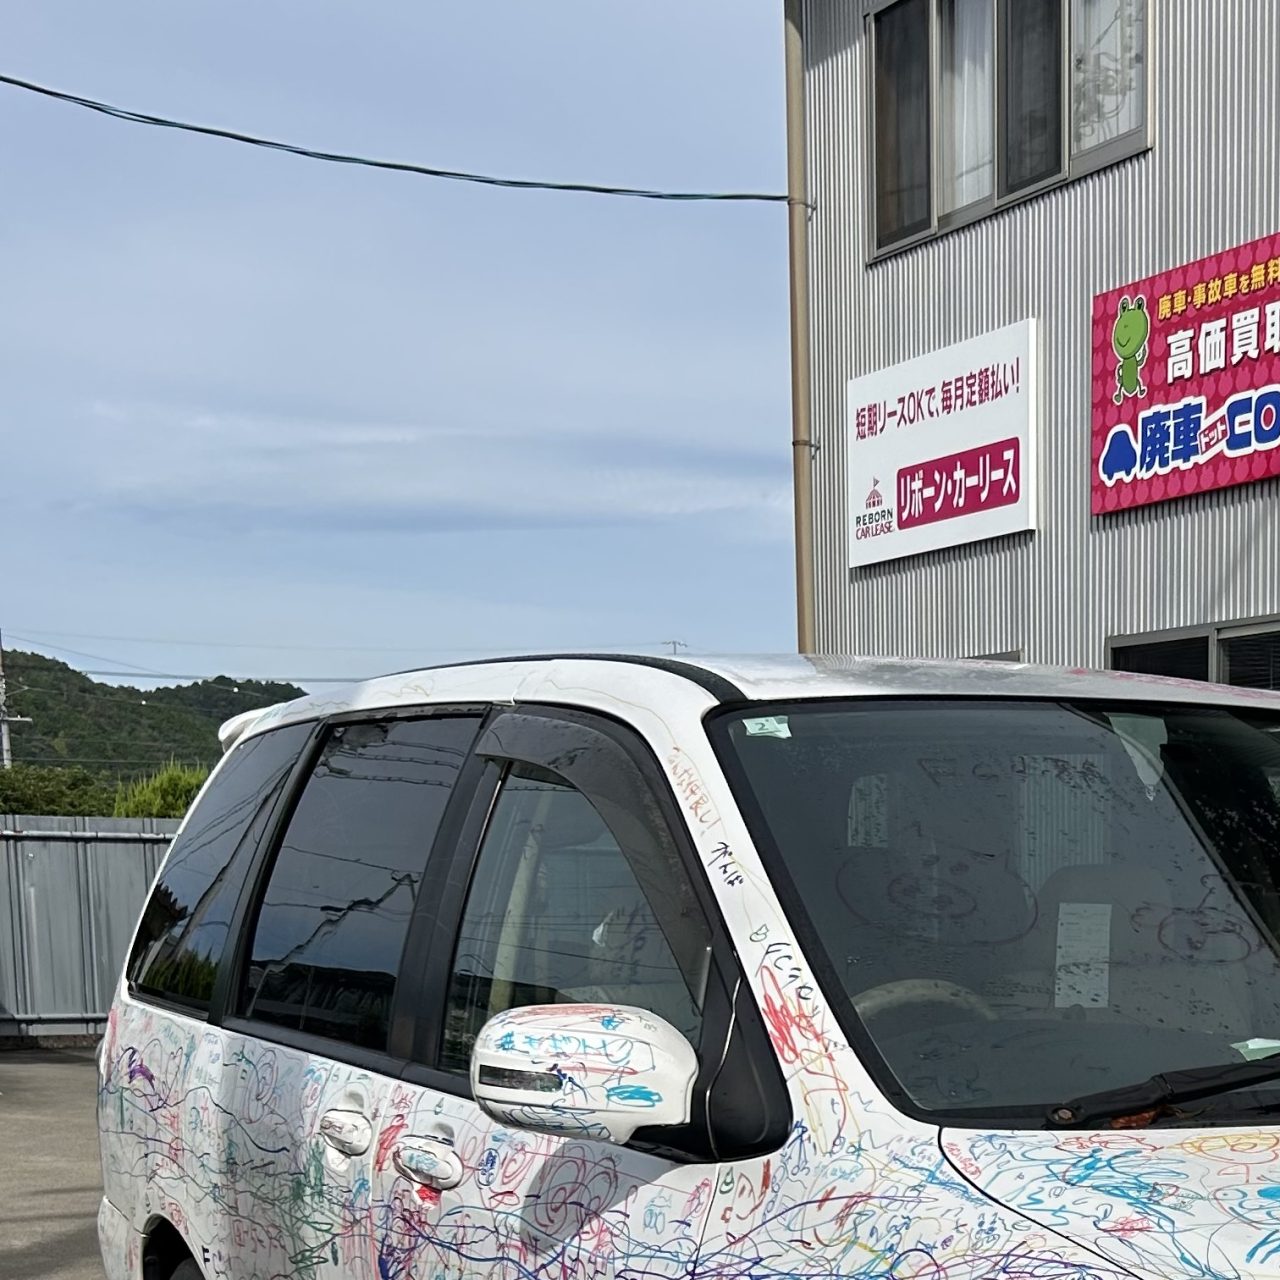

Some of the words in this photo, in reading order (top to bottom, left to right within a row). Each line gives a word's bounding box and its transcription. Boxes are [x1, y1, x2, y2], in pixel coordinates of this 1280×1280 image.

[901, 449, 1018, 522] リボーン・カーリース
[855, 508, 894, 527] REBORN
[855, 525, 871, 541] CAR
[871, 520, 894, 539] LEASE
